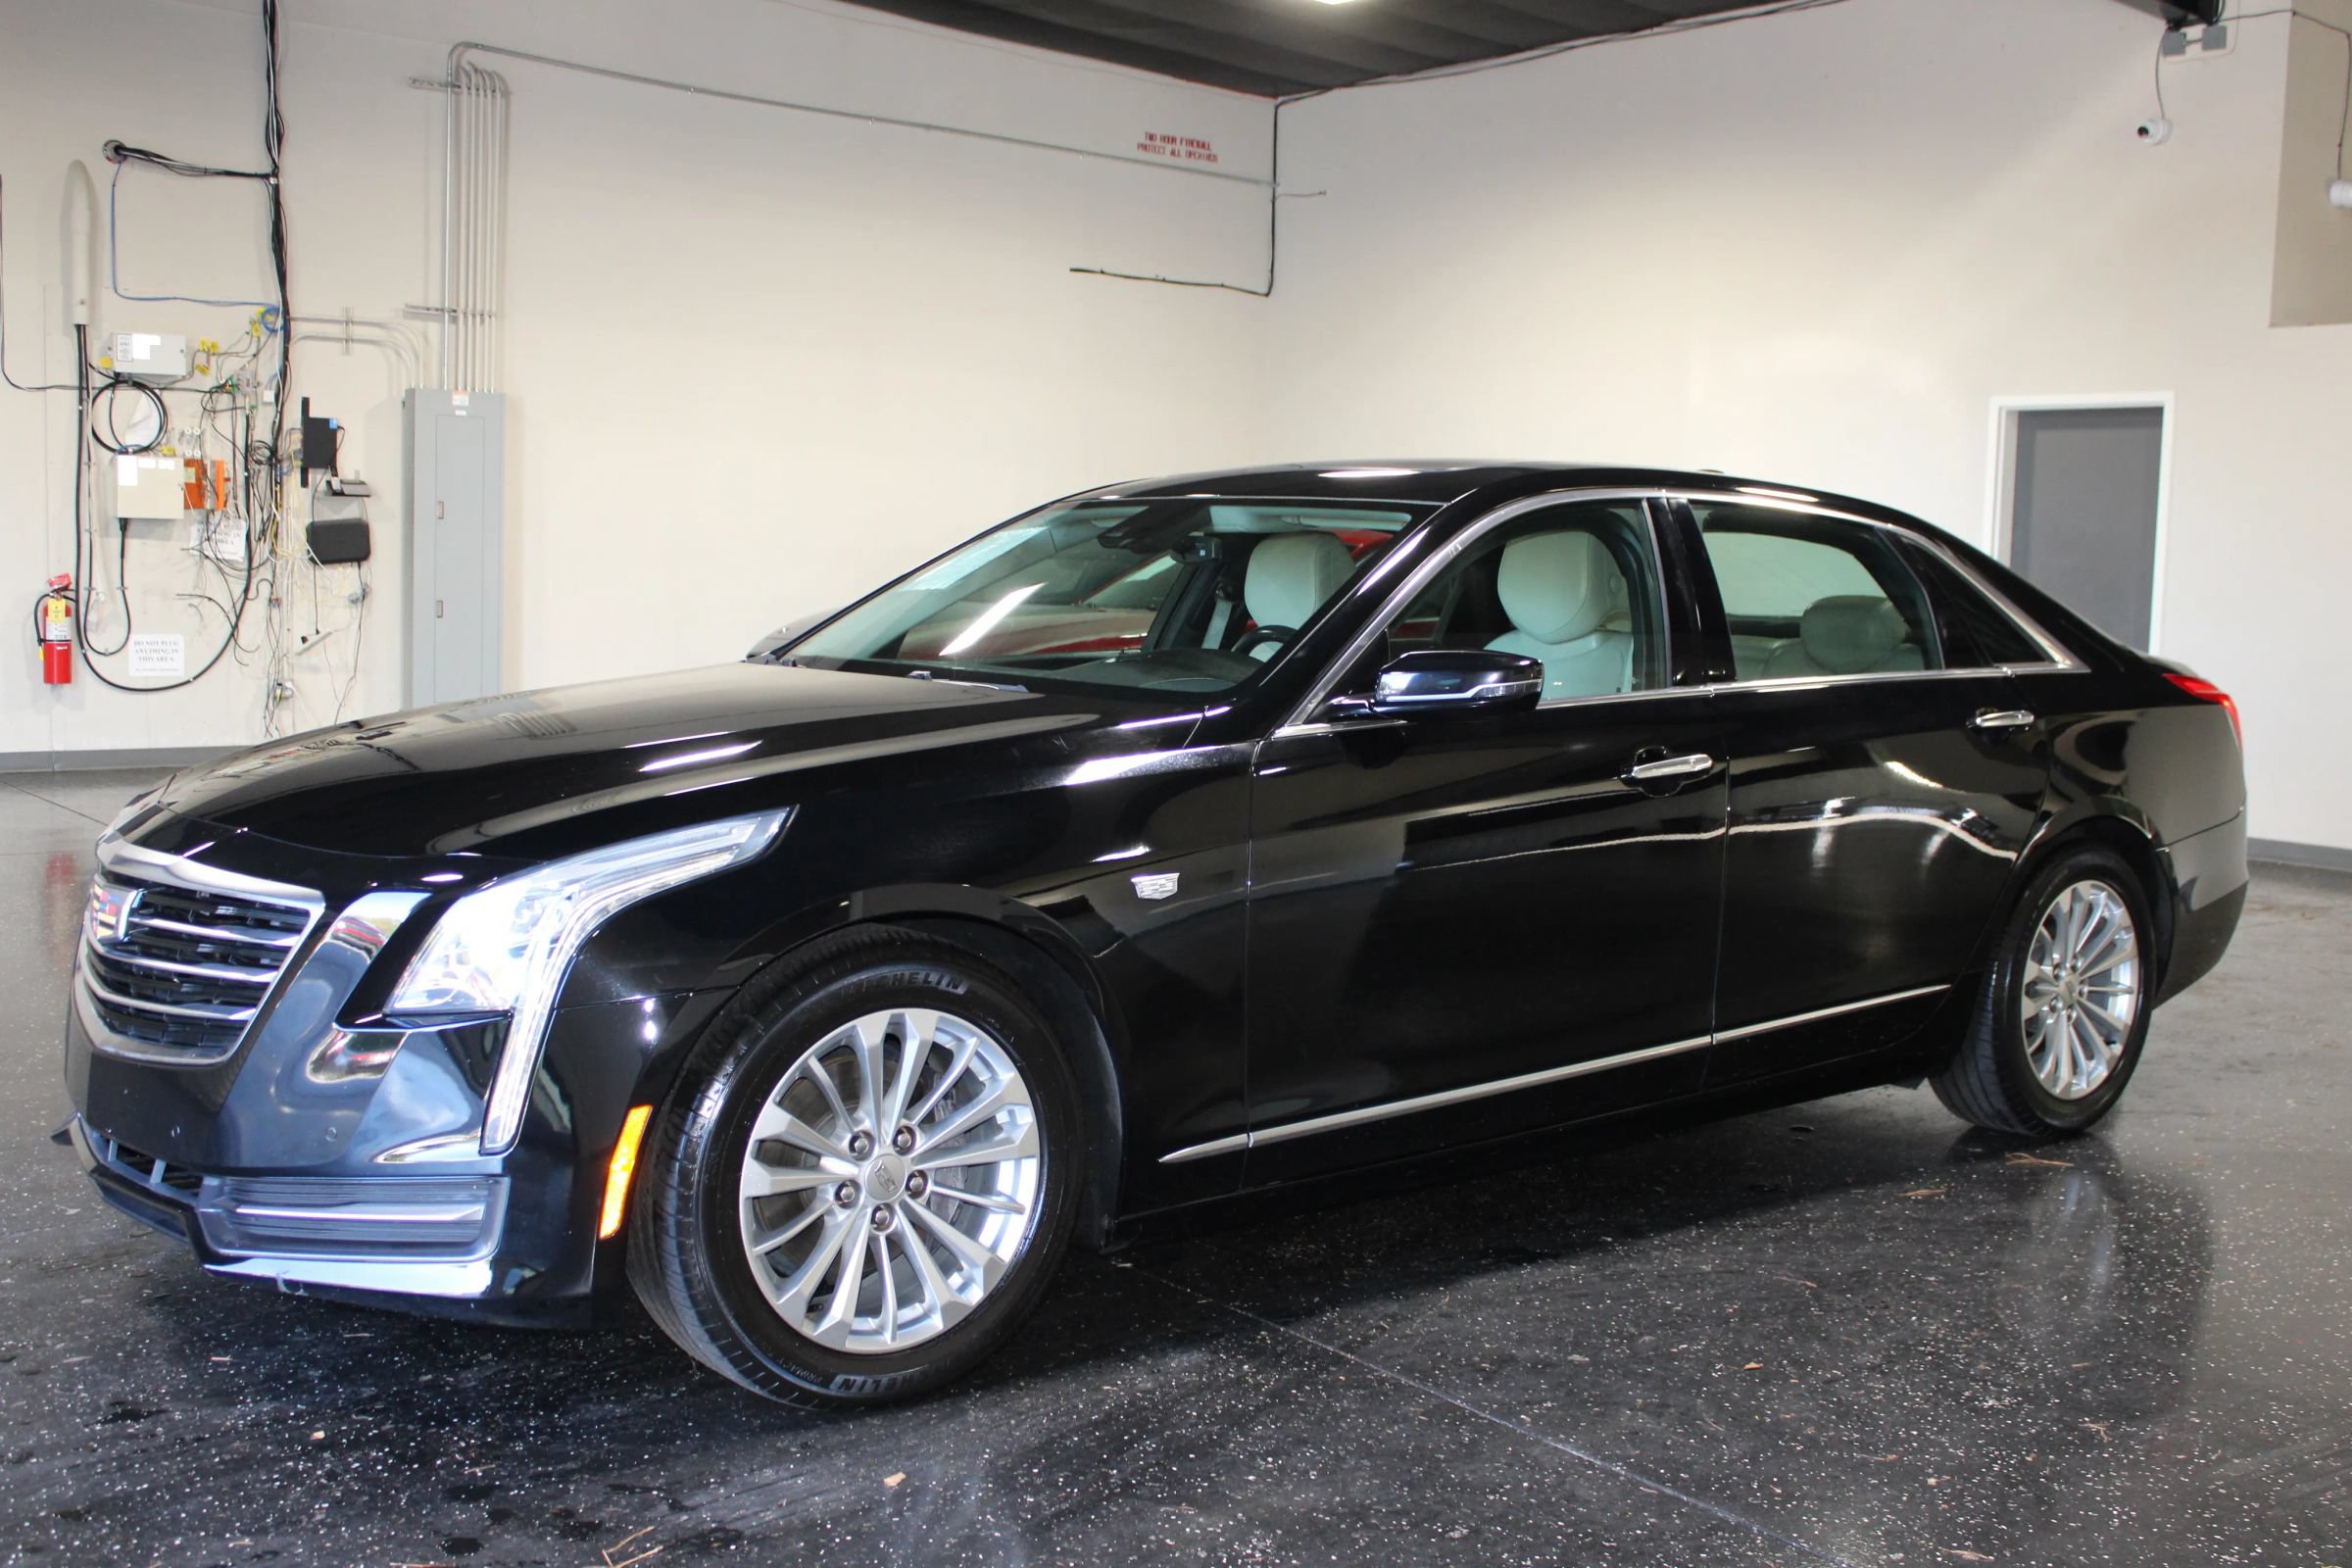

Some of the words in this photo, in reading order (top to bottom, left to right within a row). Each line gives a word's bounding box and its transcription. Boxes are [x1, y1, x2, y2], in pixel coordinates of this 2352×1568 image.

[1145, 131, 1157, 141] TWO
[1159, 133, 1177, 145] HOUR
[1137, 142, 1166, 155] PROTECT
[1170, 148, 1182, 157] ALL
